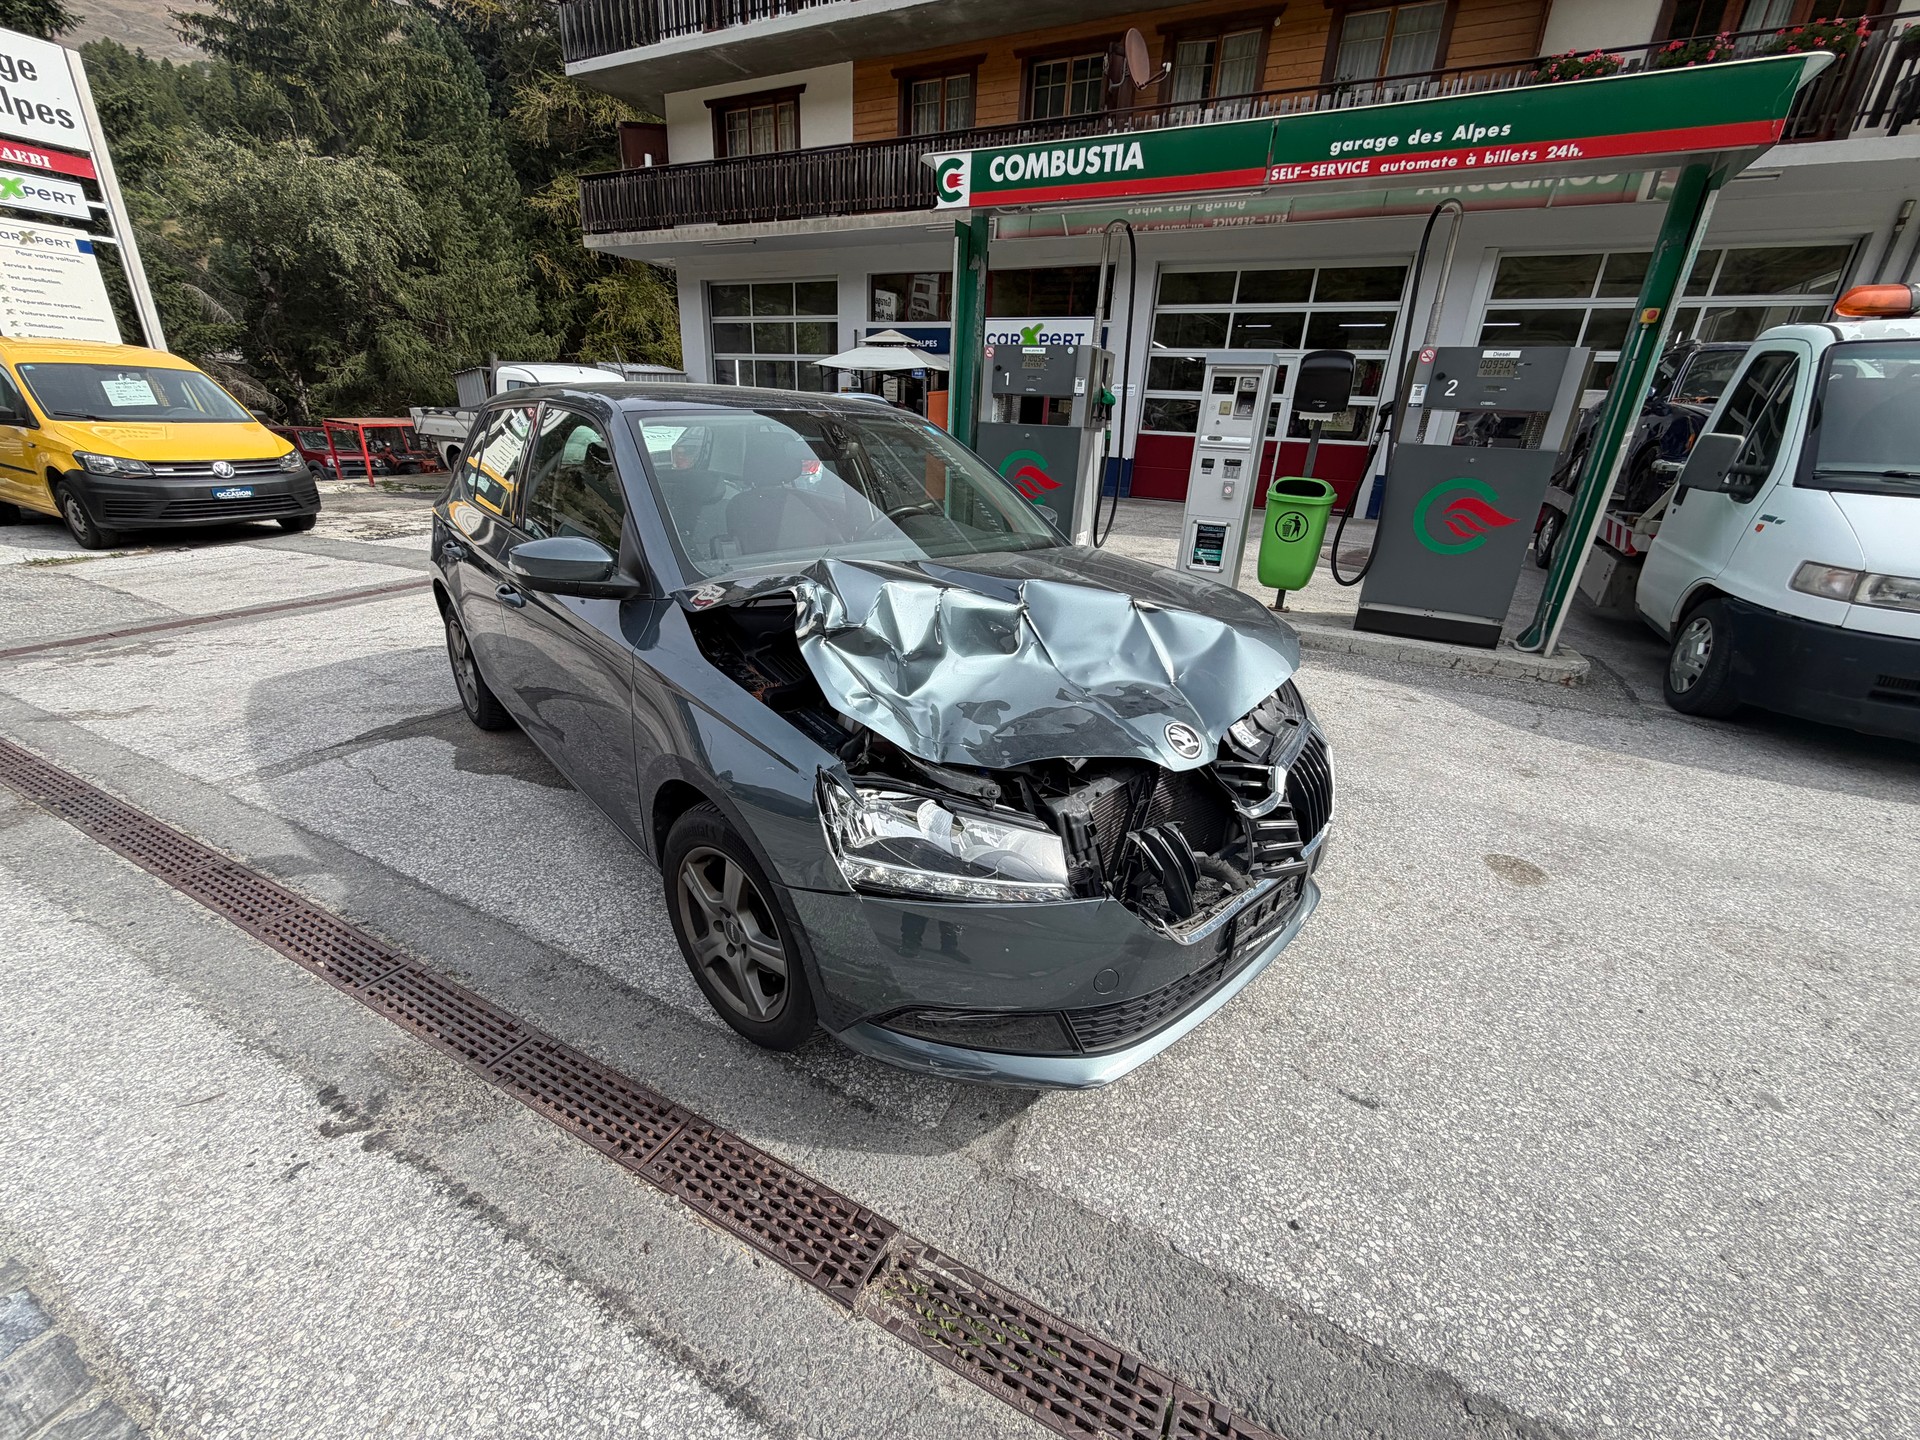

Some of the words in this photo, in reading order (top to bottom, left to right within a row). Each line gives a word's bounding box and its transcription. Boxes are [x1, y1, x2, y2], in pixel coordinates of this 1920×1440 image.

[0, 85, 75, 129] lpes
[1330, 135, 1399, 156] garage
[1407, 128, 1443, 145] des
[1451, 122, 1512, 143] Alpes
[1, 147, 52, 168] AEBI
[989, 142, 1144, 183] COMBUSTIA
[1271, 160, 1370, 181] SELF-SERVICE
[1380, 156, 1458, 173] automate
[1466, 152, 1477, 166] à
[1484, 149, 1538, 165] billets
[1545, 143, 1583, 159] 24h.
[1480, 360, 1517, 369] 009504
[1004, 372, 1010, 386] 1
[1444, 379, 1459, 397] 2
